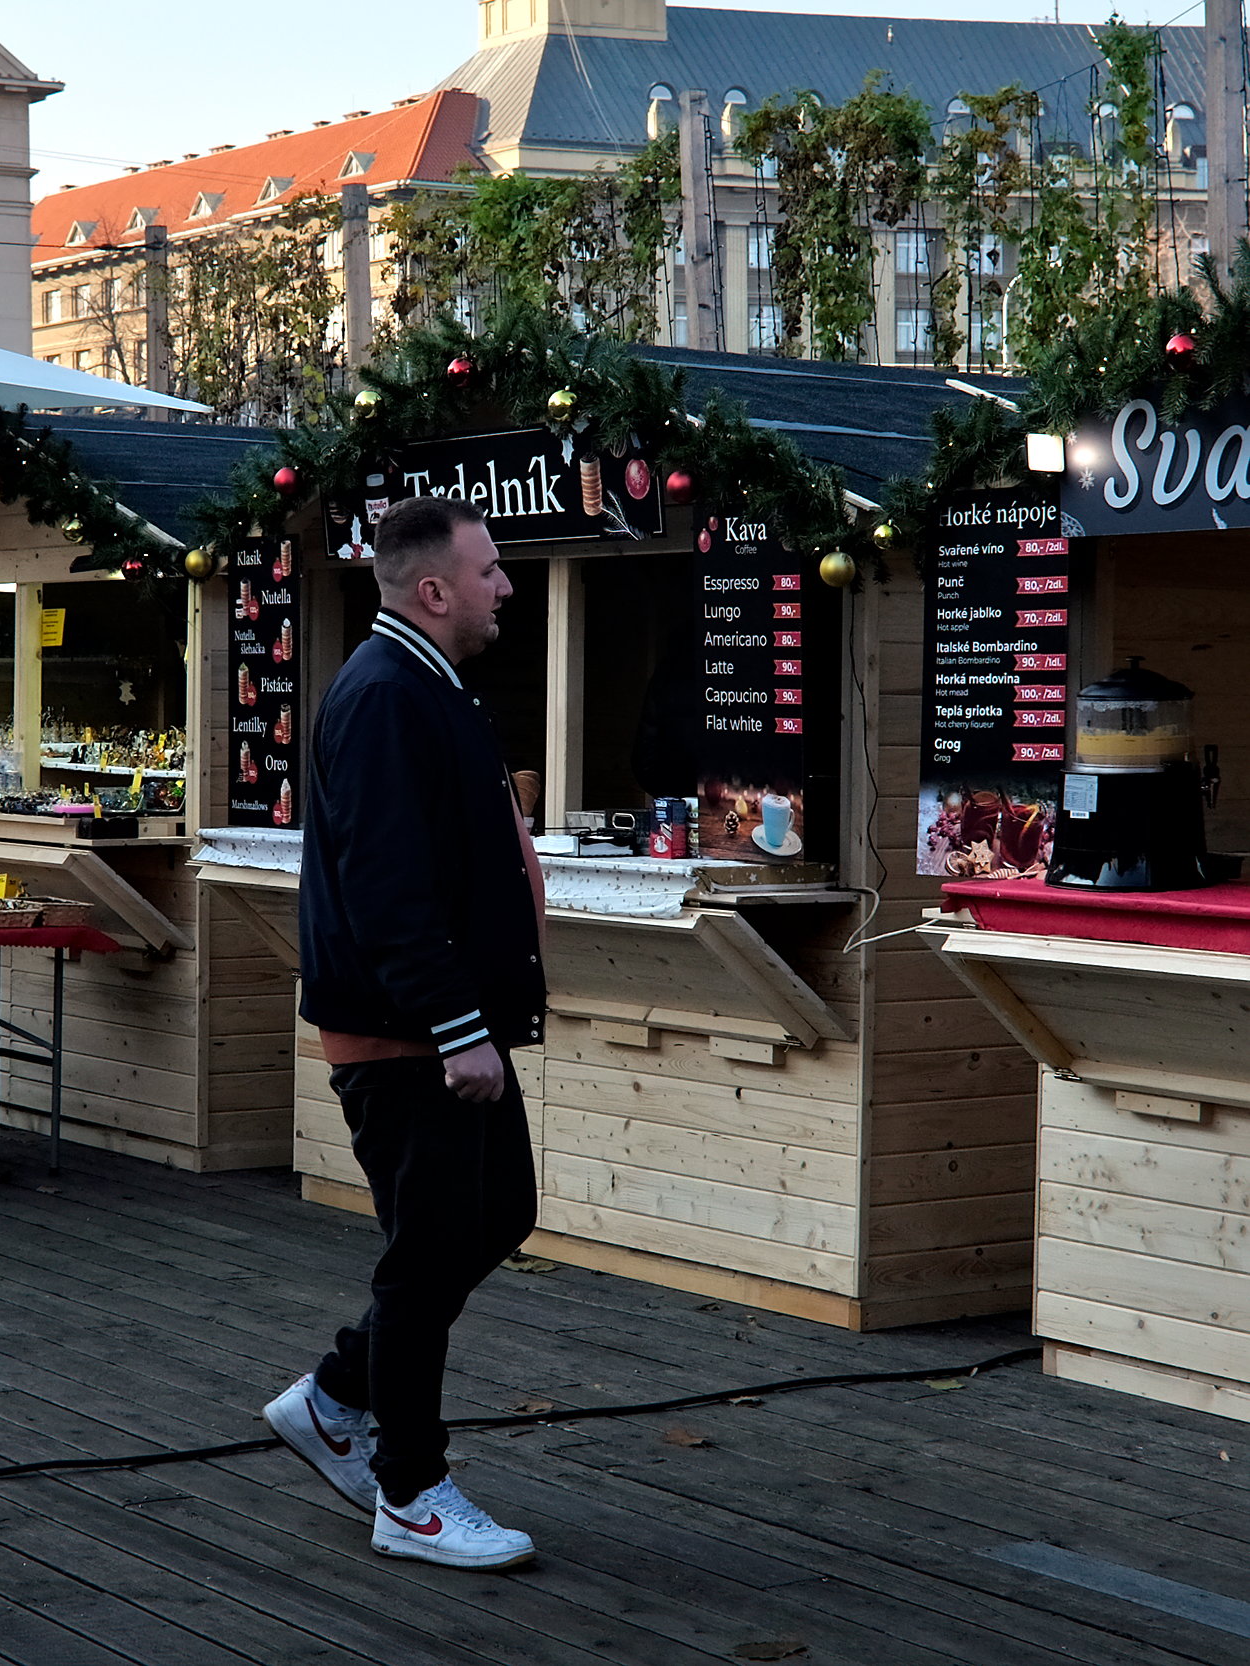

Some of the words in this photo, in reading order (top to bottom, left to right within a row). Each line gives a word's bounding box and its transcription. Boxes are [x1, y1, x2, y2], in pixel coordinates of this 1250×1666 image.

[939, 502, 991, 527] Horké
[996, 500, 1057, 529] nápoje
[237, 549, 262, 566] Klasik
[735, 544, 757, 555] Coffee
[938, 543, 980, 557] Svařené
[981, 542, 1005, 554] víno
[1025, 542, 1044, 554] 80,-
[1045, 541, 1065, 553] /2dl.
[704, 575, 760, 594] Esspresso
[780, 577, 796, 589] 80,-
[938, 575, 964, 588] Punč
[1024, 580, 1043, 592] 80,-
[1044, 579, 1063, 590] /2dl.
[261, 588, 291, 605] Nutella
[937, 591, 959, 600] Punch
[704, 603, 741, 622] Lungo
[781, 605, 797, 617] 90,-
[937, 607, 968, 620] Horké
[968, 606, 1002, 622] jablko
[1024, 613, 1042, 624] 70,-
[1044, 612, 1063, 623] /2dl.
[234, 629, 255, 641] Nutella
[950, 624, 970, 632] apple
[704, 631, 767, 647] Americano
[781, 635, 797, 646] 80,-
[936, 641, 970, 653] Italské
[972, 639, 1038, 652] Bombardino
[705, 659, 734, 674] Latte
[782, 662, 797, 673] 90,-
[936, 656, 956, 665] Italian
[958, 656, 1000, 664] Bombardino
[1021, 657, 1040, 668] 90,-
[260, 676, 293, 693] Pistácie
[936, 672, 966, 685] Horká
[968, 672, 1020, 684] medovina
[705, 687, 768, 706] Cappucino
[782, 691, 798, 703] 90,-
[949, 688, 969, 696] mead
[1020, 689, 1042, 700] 100,-
[1043, 688, 1062, 699] /2dl.
[706, 714, 728, 730] Flat
[729, 715, 763, 732] white
[782, 720, 798, 732] 90,-
[935, 705, 963, 719] Teplá
[965, 705, 1003, 719] griotka
[1022, 713, 1040, 724] 90,-
[1042, 713, 1061, 723] /2dl.
[232, 716, 267, 737] Lentilky
[947, 720, 969, 729] cherry
[934, 738, 961, 752] Grog
[1020, 747, 1039, 758] 90,-
[1041, 747, 1060, 757] /2dl.
[265, 754, 288, 771] Oreo
[934, 753, 951, 763] Grog
